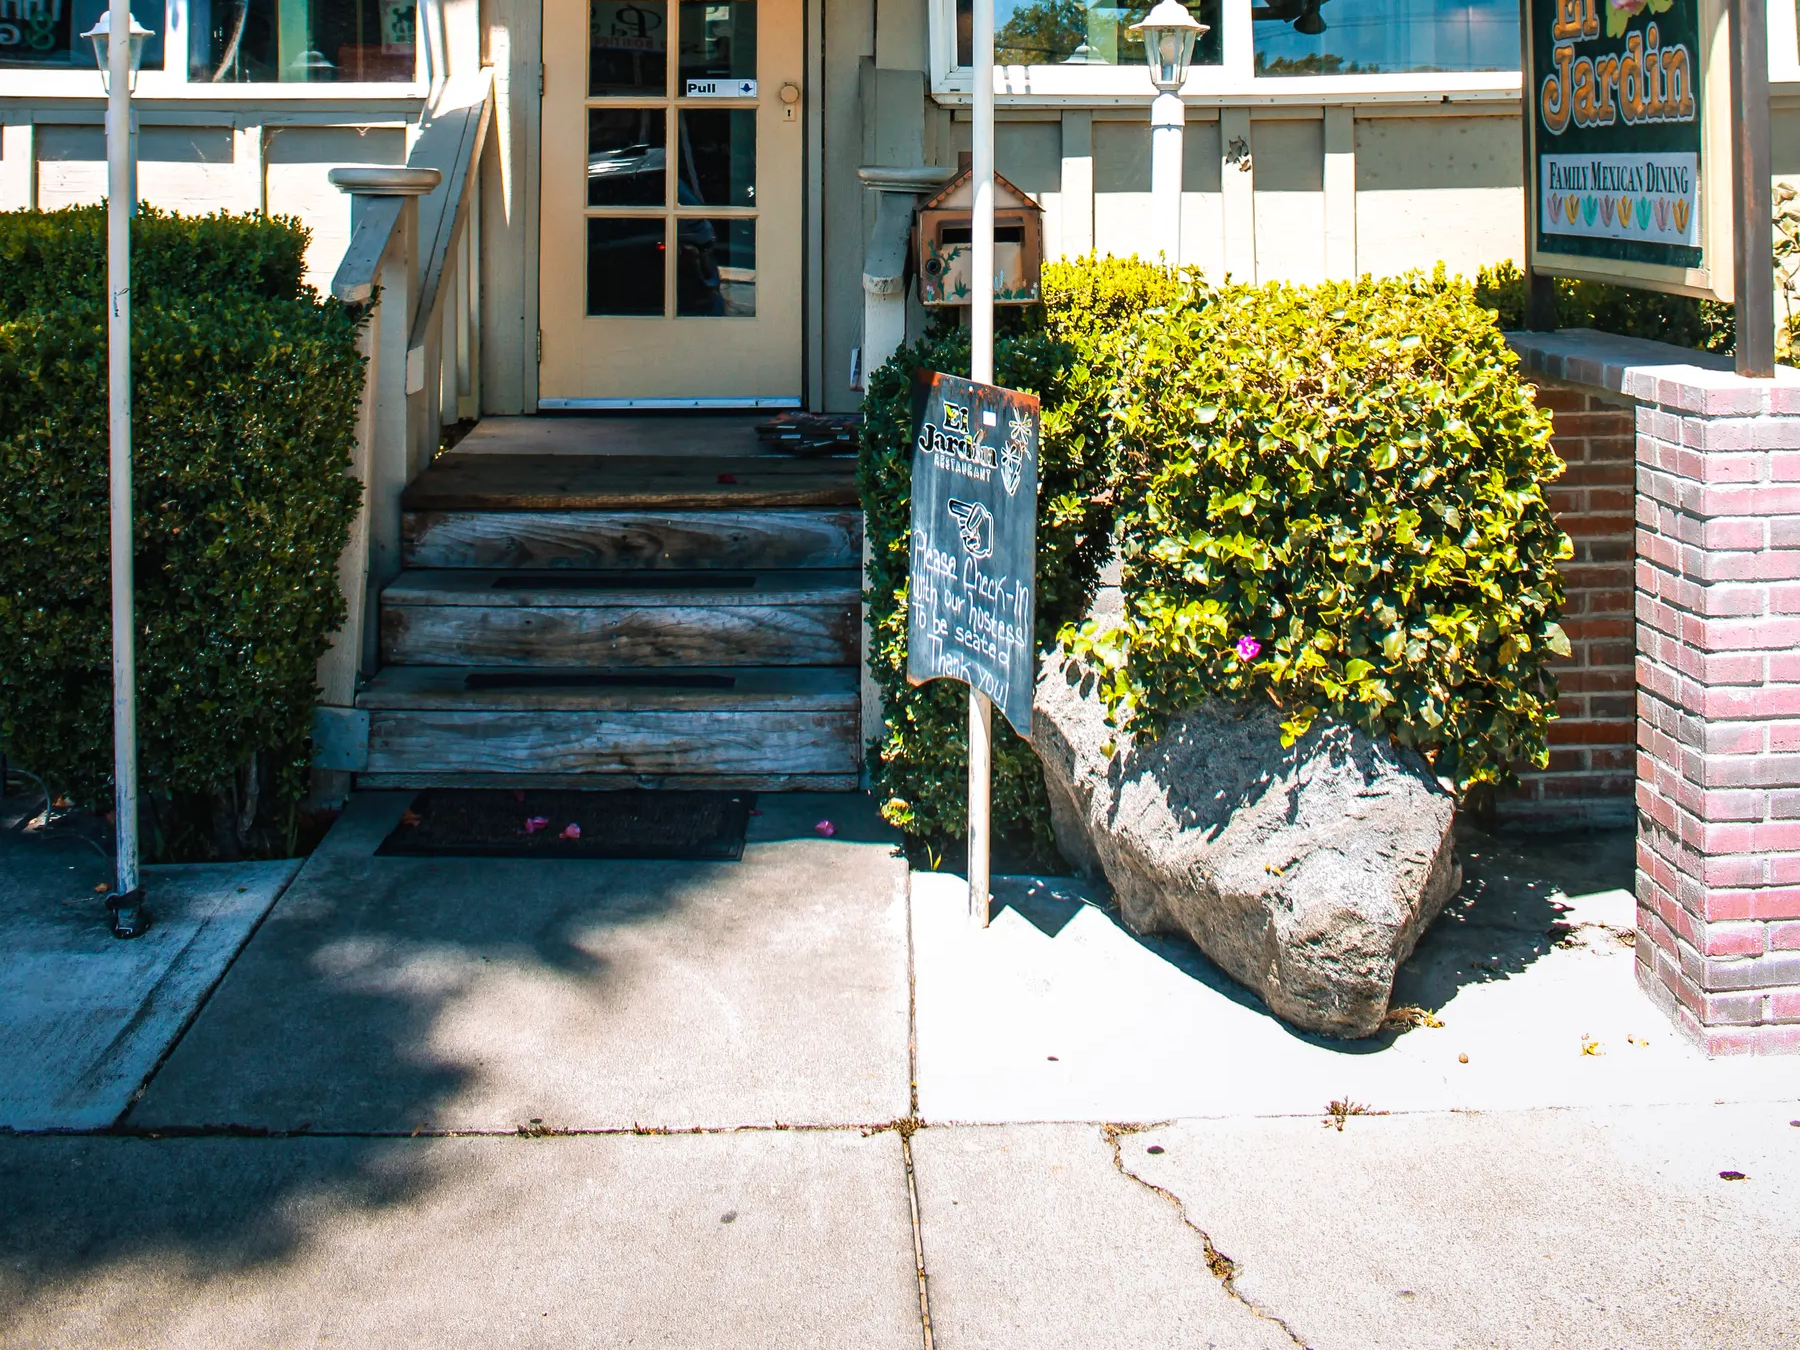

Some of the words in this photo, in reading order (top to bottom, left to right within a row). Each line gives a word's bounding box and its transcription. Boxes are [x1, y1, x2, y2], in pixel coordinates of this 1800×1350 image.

[687, 83, 716, 93] Pull
[1541, 21, 1695, 135] Jardin
[1549, 162, 1588, 191] FAMILY
[1590, 161, 1644, 192] MEXICAN
[1646, 162, 1688, 193] DINING
[943, 400, 969, 434] El
[933, 453, 991, 482] RESTAURANT
[914, 530, 958, 580] Please
[912, 601, 927, 629] To
[932, 610, 948, 635] be
[955, 626, 1010, 670] seated
[944, 589, 965, 615] our
[968, 591, 1025, 647] hostess
[927, 634, 972, 684] Thank
